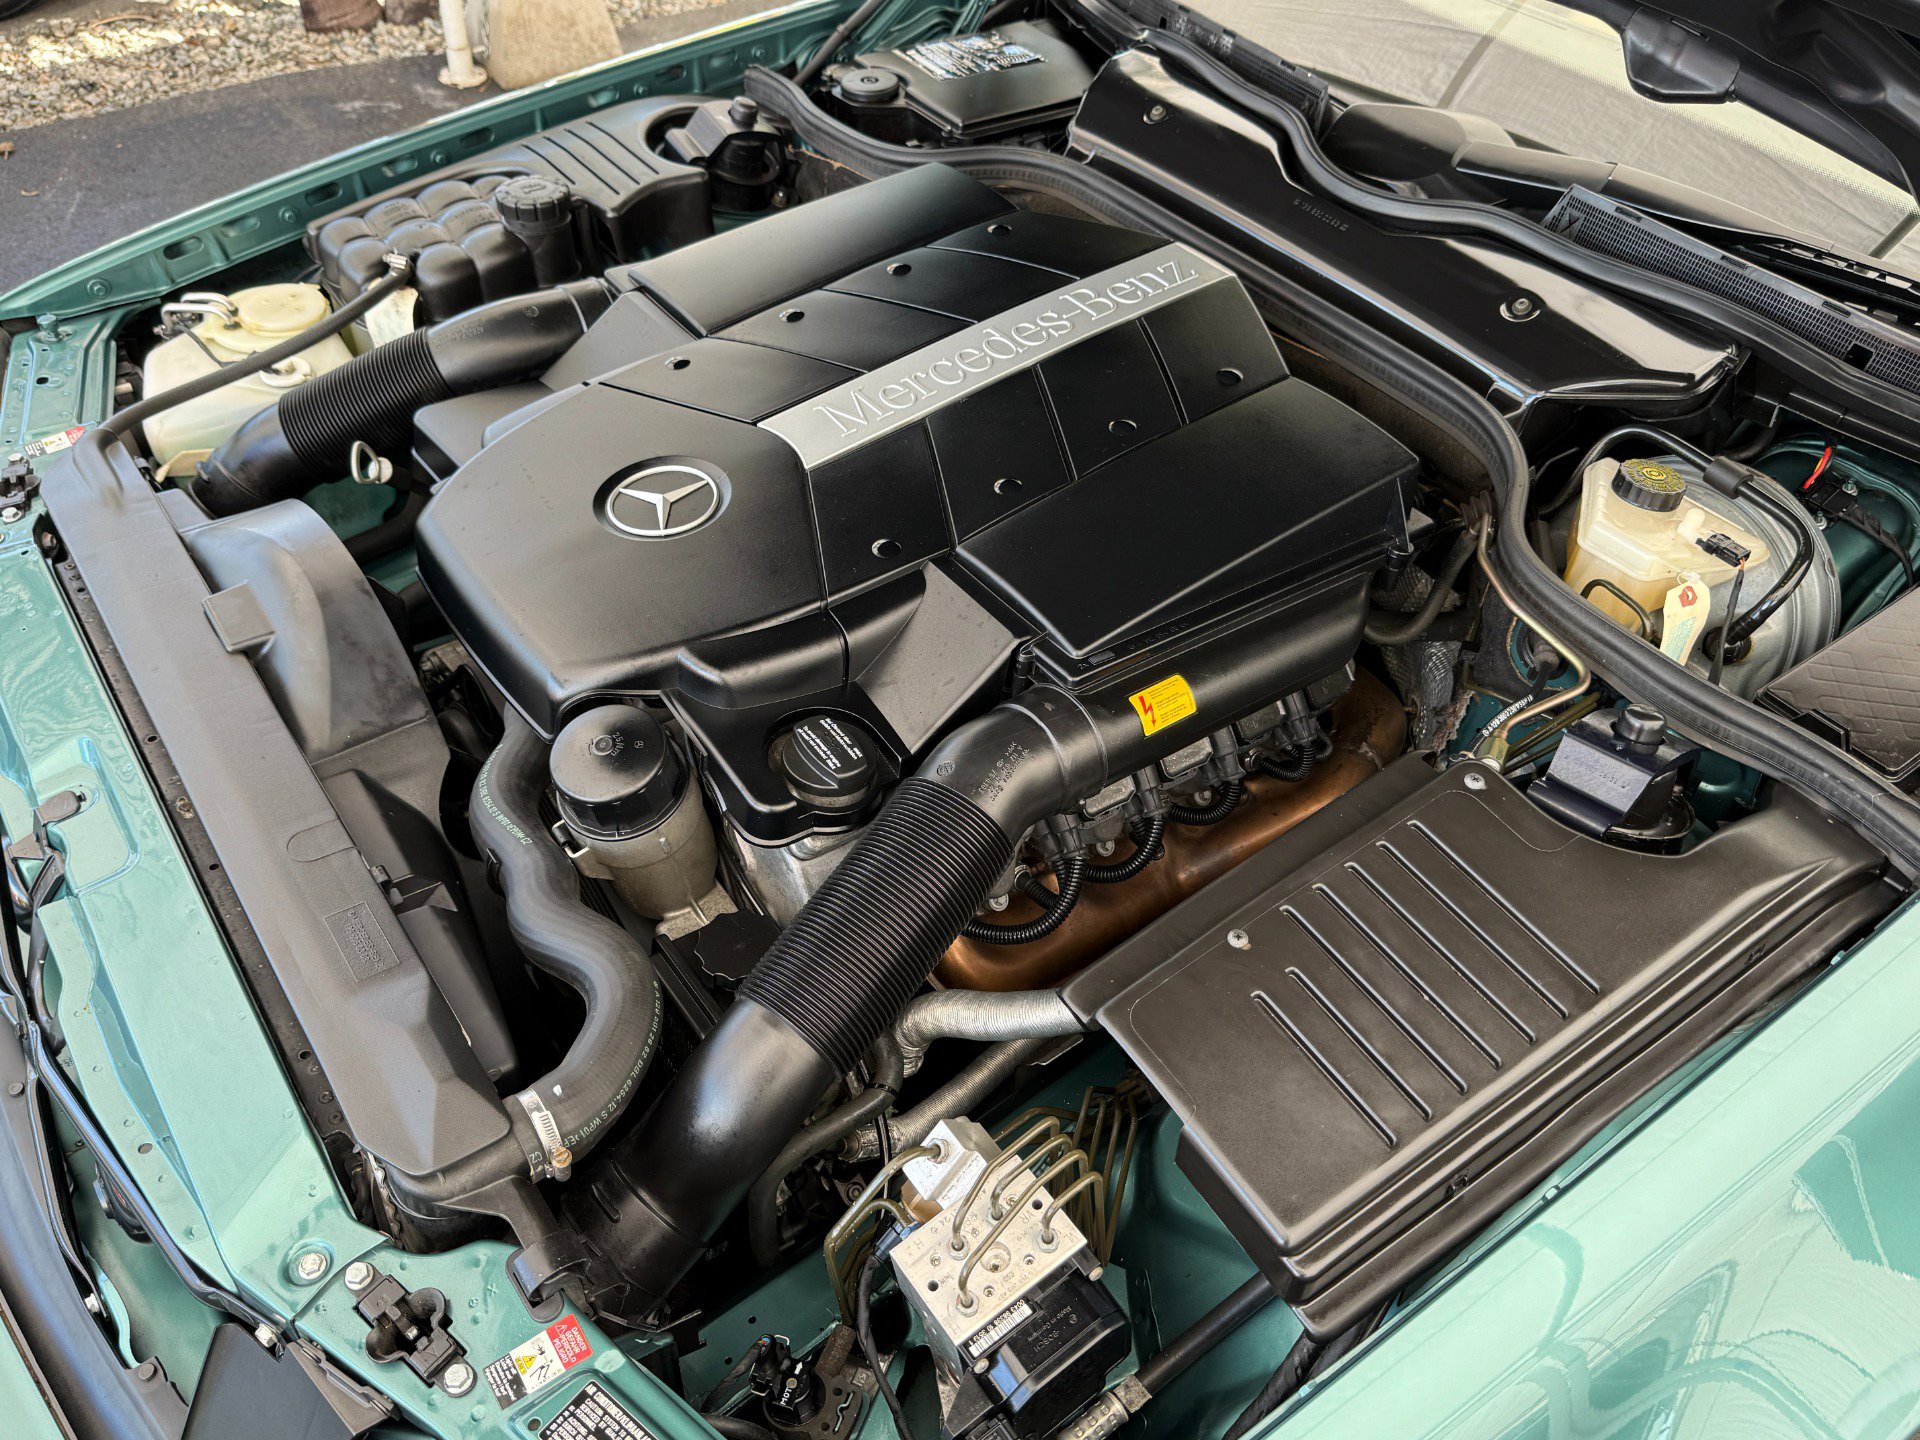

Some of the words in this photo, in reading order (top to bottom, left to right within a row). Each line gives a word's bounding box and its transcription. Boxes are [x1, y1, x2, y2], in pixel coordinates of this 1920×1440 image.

[813, 257, 1199, 438] Mercedes-Benz
[630, 1060, 644, 1079] DBL
[602, 1111, 609, 1120] S
[579, 1117, 602, 1139] WP01
[528, 1151, 542, 1163] CZ
[565, 1331, 579, 1353] GEFAHR
[571, 1327, 587, 1351] DANGER
[1025, 1321, 1052, 1342] Germany
[1031, 1330, 1060, 1352] BOSCH
[553, 1338, 569, 1363] PELIGRO
[558, 1334, 576, 1362] PERICOLO
[585, 1383, 596, 1394] AIR
[780, 1387, 792, 1406] MOT
[573, 1408, 597, 1430] PERSONNEL
[579, 1403, 599, 1422] SERVICED
[602, 1414, 620, 1431] SYSTEM
[562, 1421, 576, 1435] DURCH
